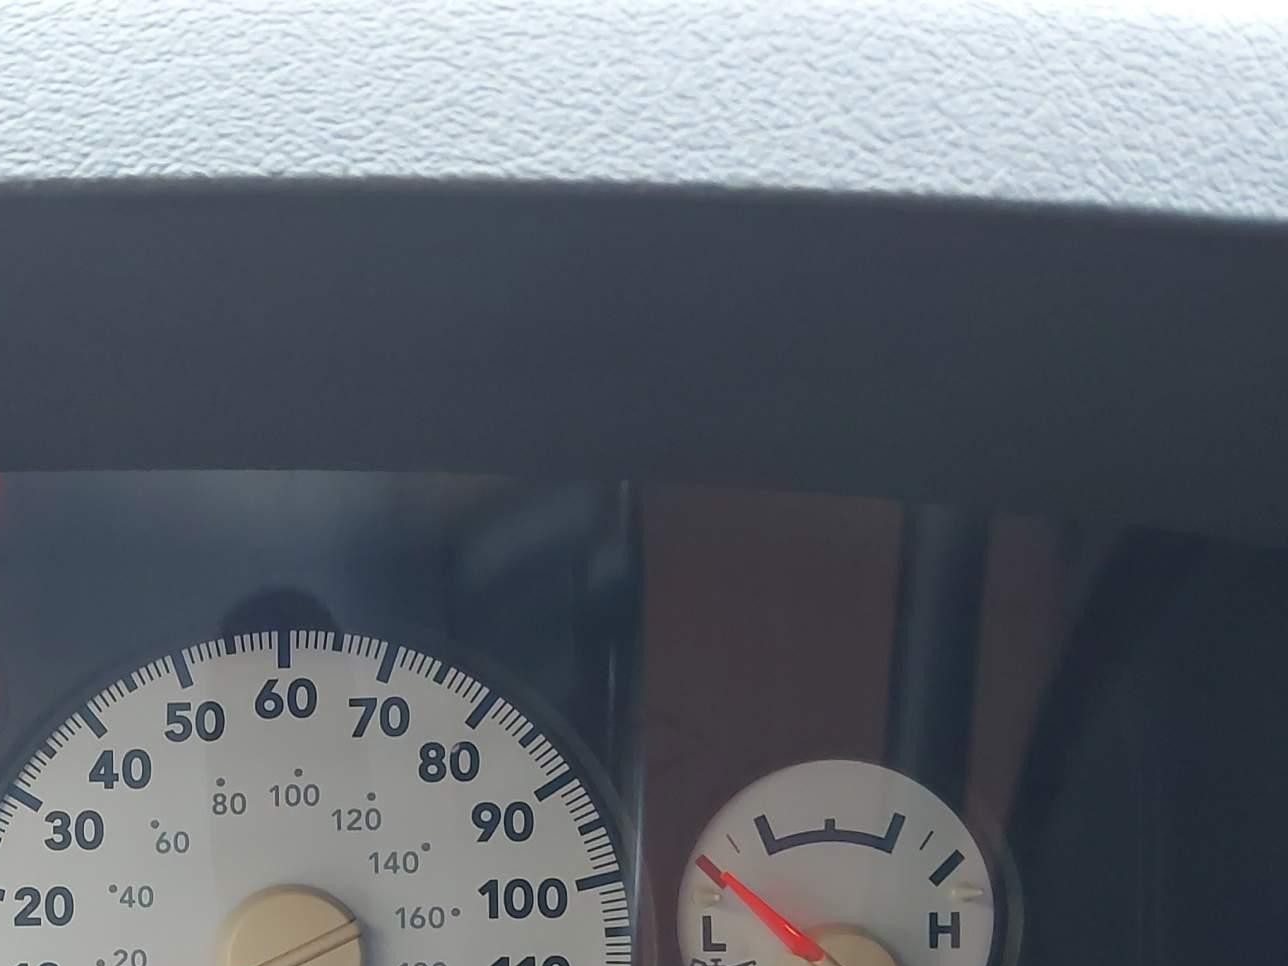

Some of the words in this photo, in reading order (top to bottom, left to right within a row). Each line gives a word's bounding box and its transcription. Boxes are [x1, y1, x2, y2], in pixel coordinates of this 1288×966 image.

[255, 678, 317, 719] 60
[349, 697, 410, 737] 70
[165, 701, 225, 742] 50
[89, 749, 151, 789] 40
[419, 741, 479, 782] 80
[213, 793, 246, 815] 80
[270, 784, 319, 807] 100
[45, 810, 104, 850] 30
[332, 808, 381, 831] 120
[472, 801, 534, 842] 90
[155, 832, 189, 854] 60
[369, 852, 418, 874] 140
[14, 887, 74, 926] 20
[120, 886, 153, 908] 40
[478, 878, 567, 919] 100
[395, 907, 444, 929] 160
[702, 916, 726, 952] L
[929, 912, 960, 949] H
